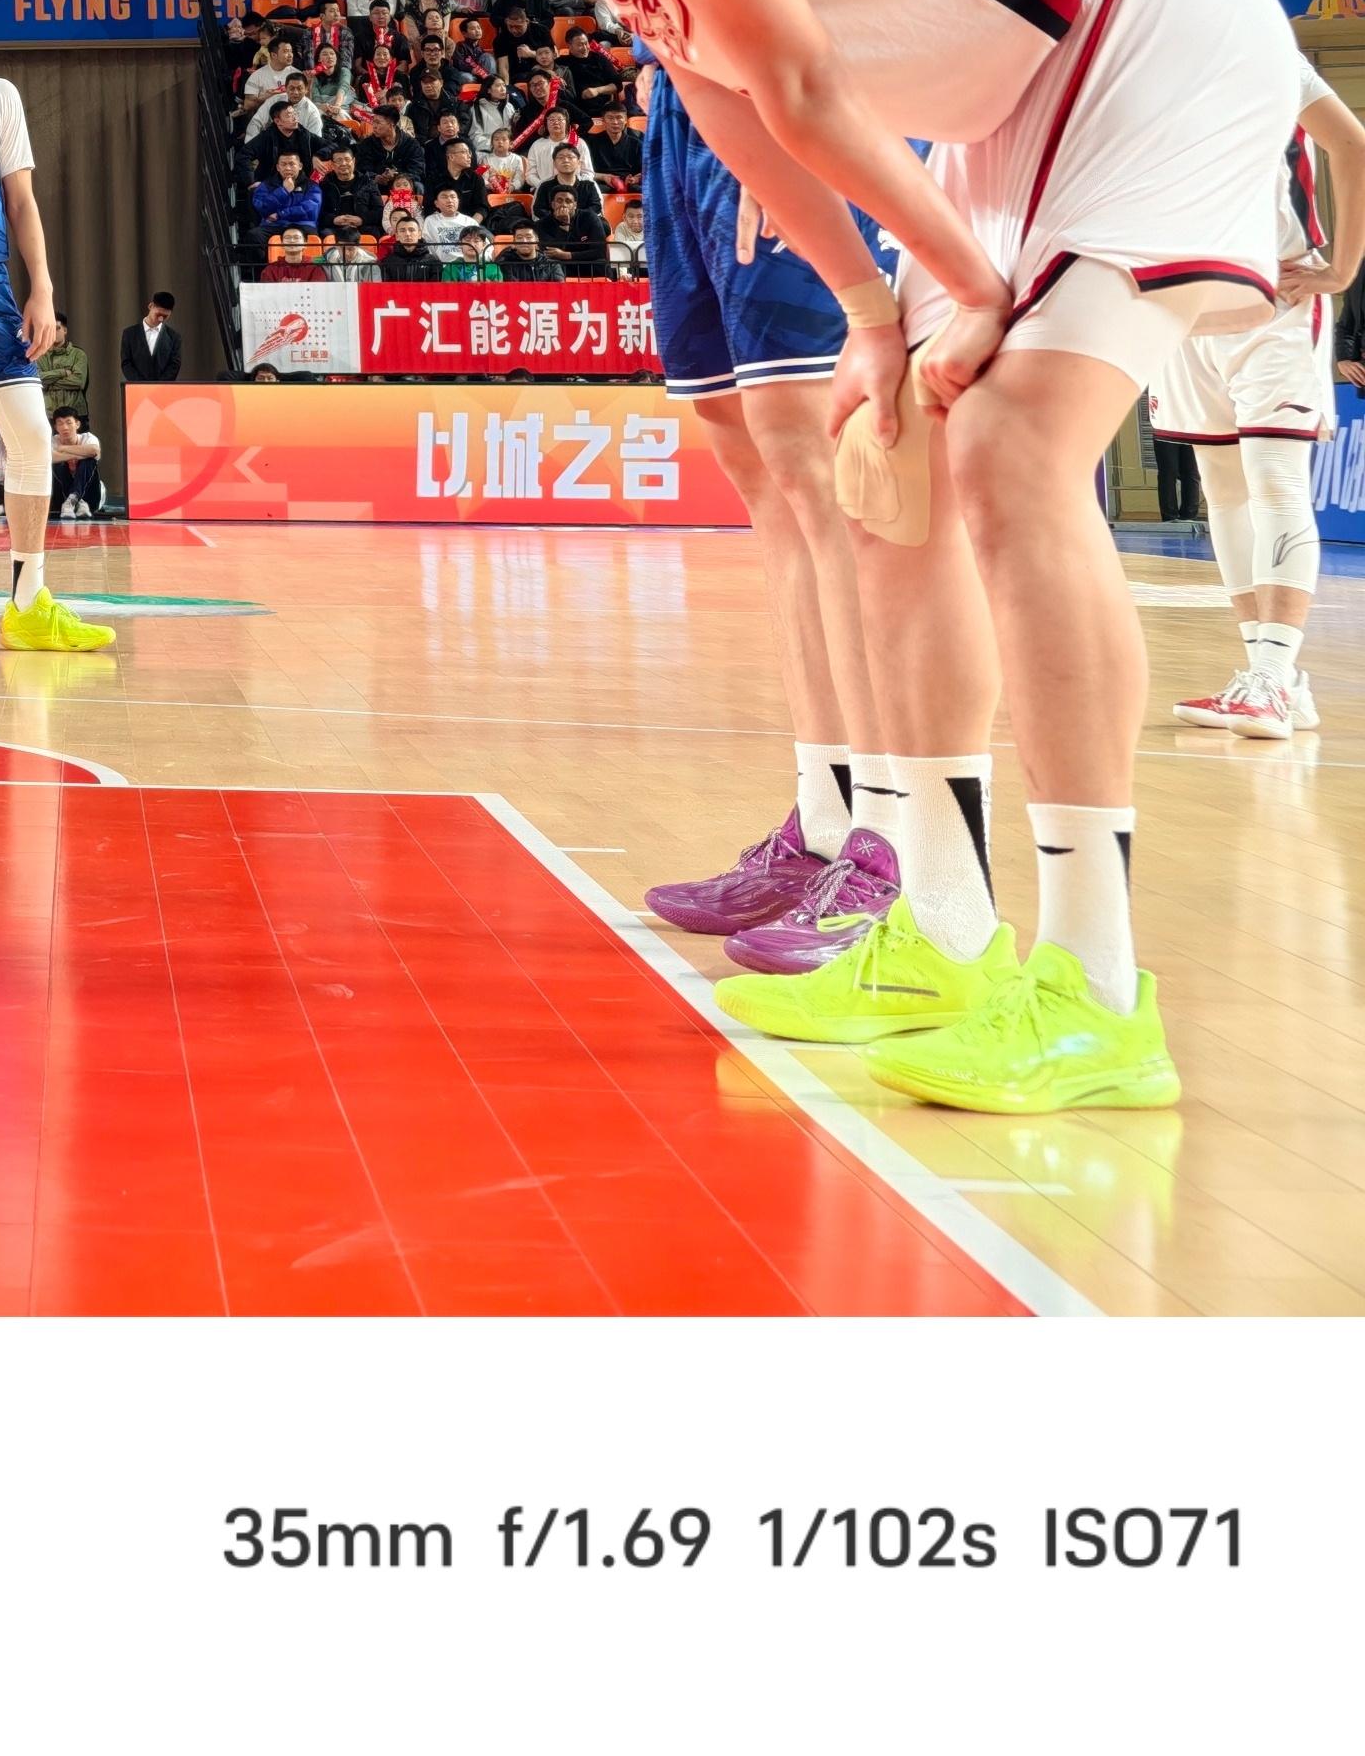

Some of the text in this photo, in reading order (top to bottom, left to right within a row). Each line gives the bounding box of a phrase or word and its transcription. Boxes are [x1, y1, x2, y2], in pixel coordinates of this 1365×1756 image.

[370, 299, 658, 357] 广汇能源为新
[416, 409, 680, 501] 以城之名
